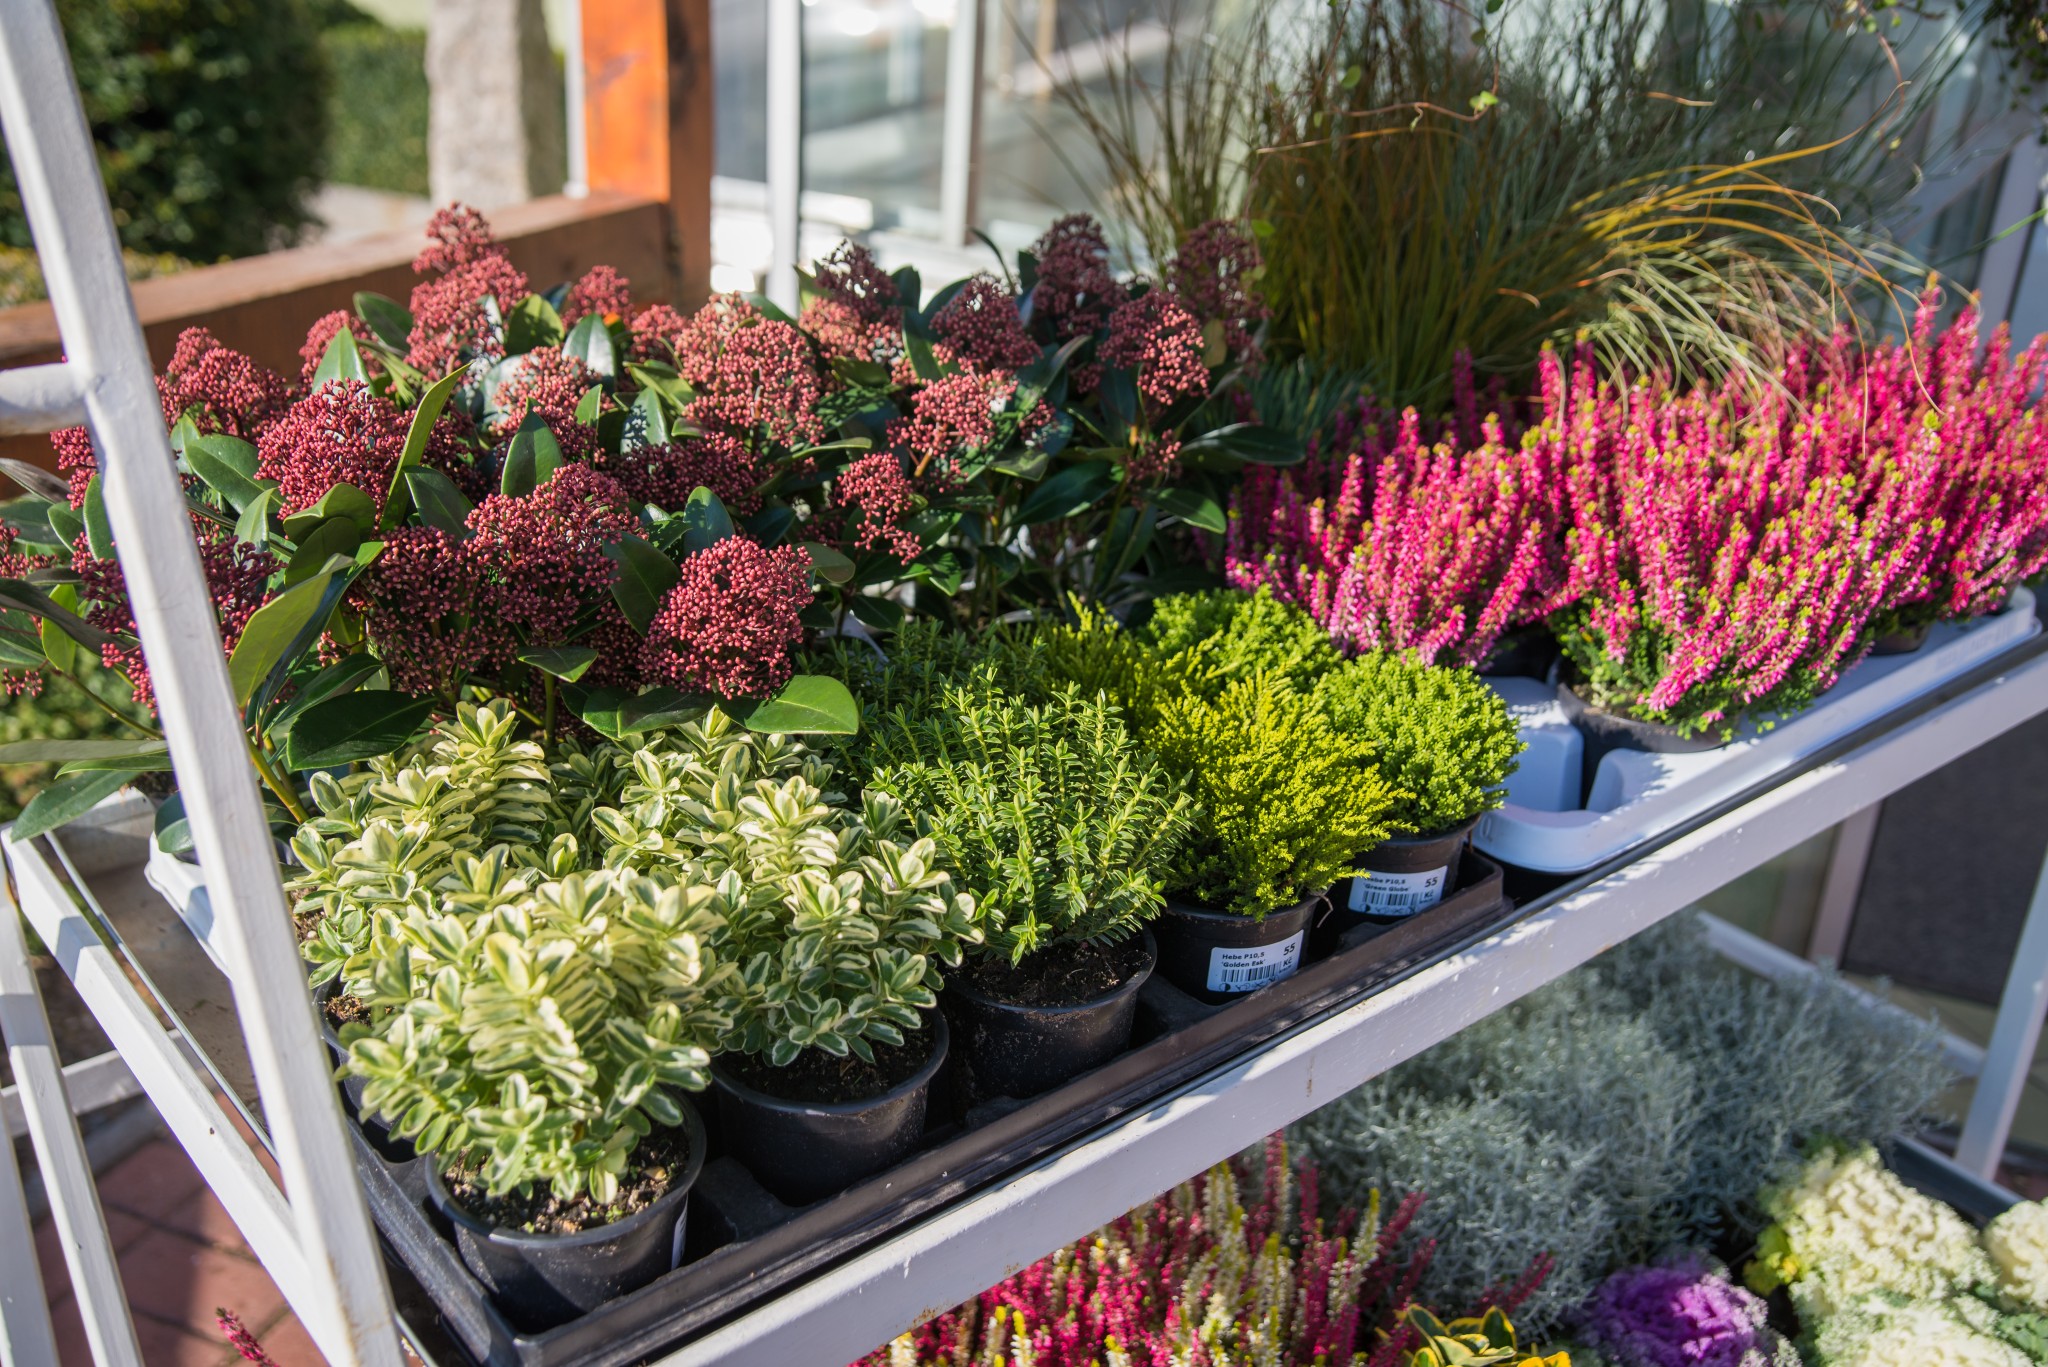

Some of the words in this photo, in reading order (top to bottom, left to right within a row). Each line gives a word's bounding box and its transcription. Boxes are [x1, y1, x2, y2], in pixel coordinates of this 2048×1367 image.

[1424, 876, 1438, 888] 55
[1244, 951, 1265, 959] P10,5
[1283, 942, 1296, 956] 55
